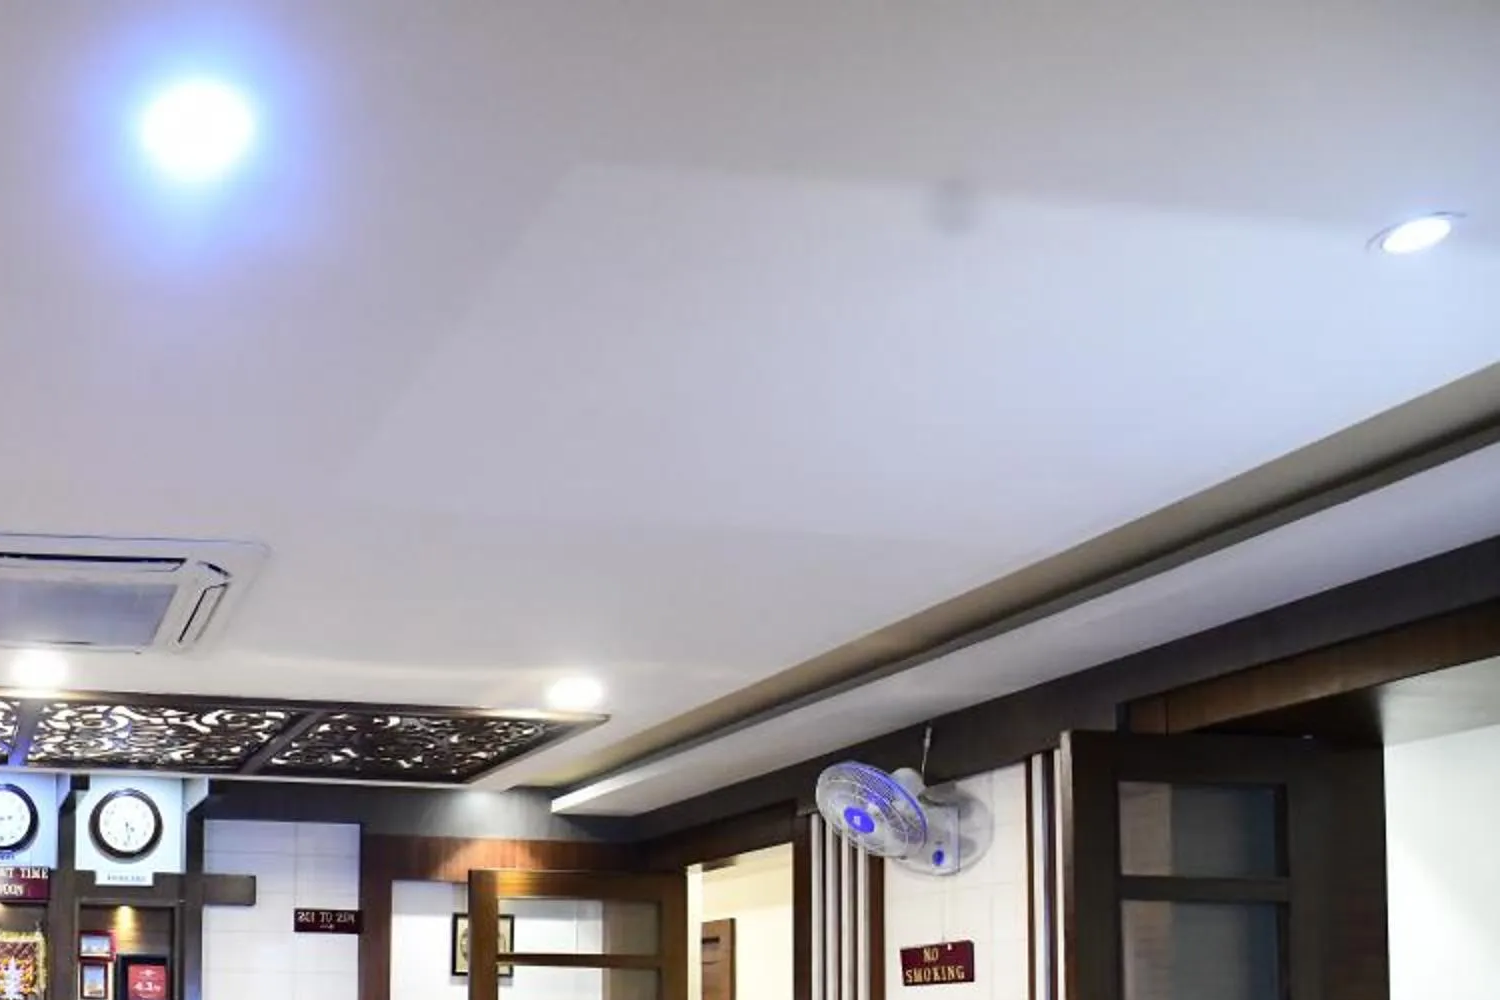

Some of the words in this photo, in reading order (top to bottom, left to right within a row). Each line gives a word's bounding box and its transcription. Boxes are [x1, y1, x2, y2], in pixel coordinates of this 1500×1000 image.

[320, 911, 332, 923] TO
[923, 947, 939, 962] NO
[905, 965, 965, 983] SMOKING
